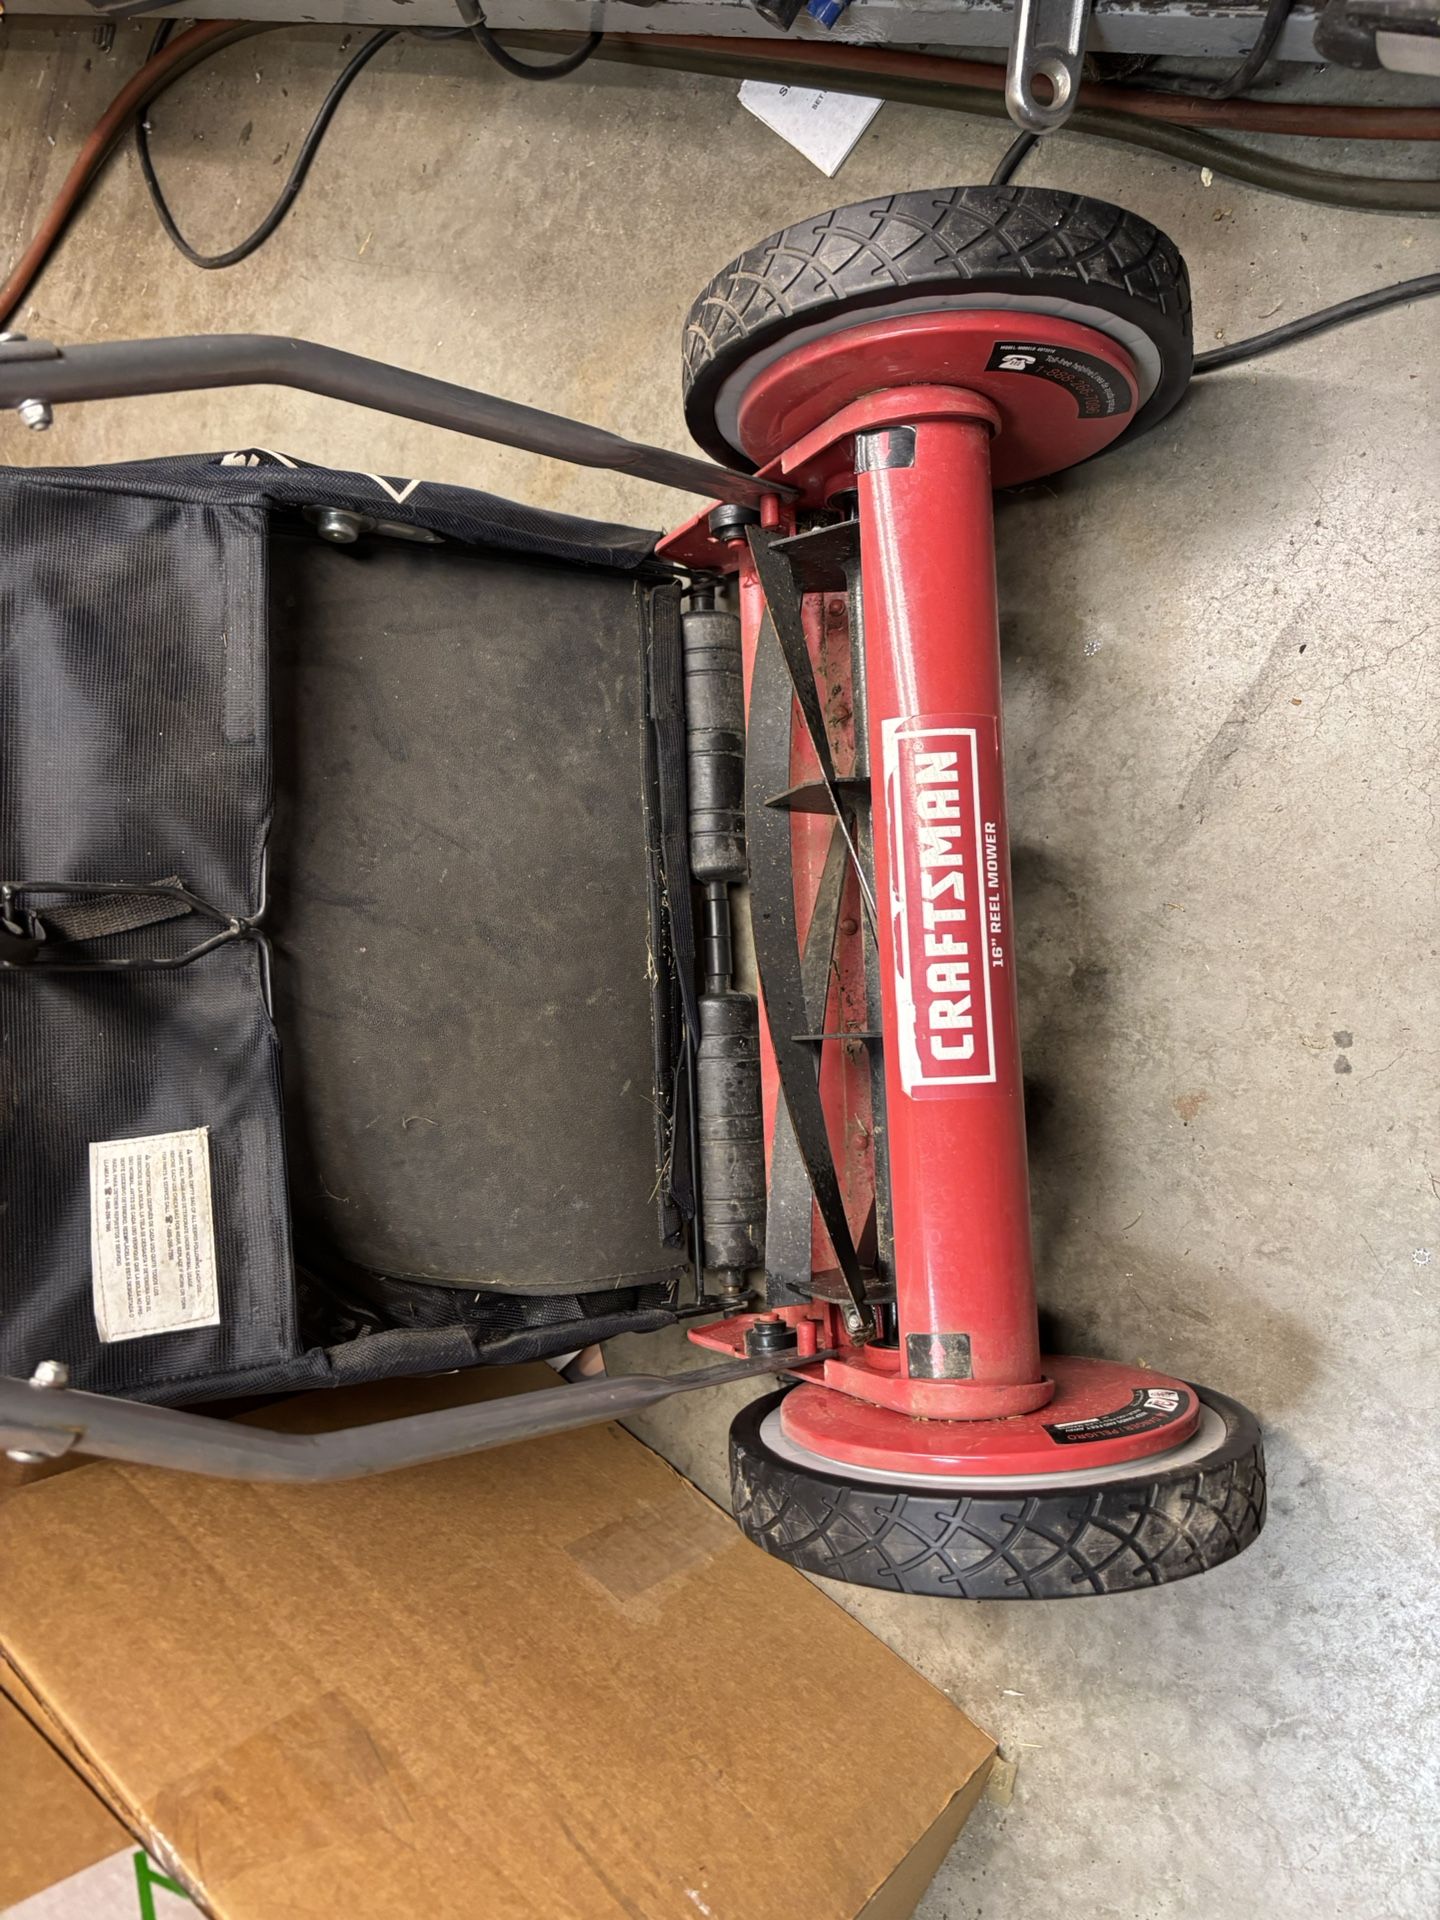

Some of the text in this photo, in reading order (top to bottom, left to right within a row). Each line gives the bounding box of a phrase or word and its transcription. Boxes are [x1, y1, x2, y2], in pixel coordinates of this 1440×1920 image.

[984, 821, 1000, 888] MOWER
[914, 752, 975, 1061] CRAFTSMAN
[988, 893, 1002, 933] REEL
[1067, 1428, 1120, 1440] PELIGRO
